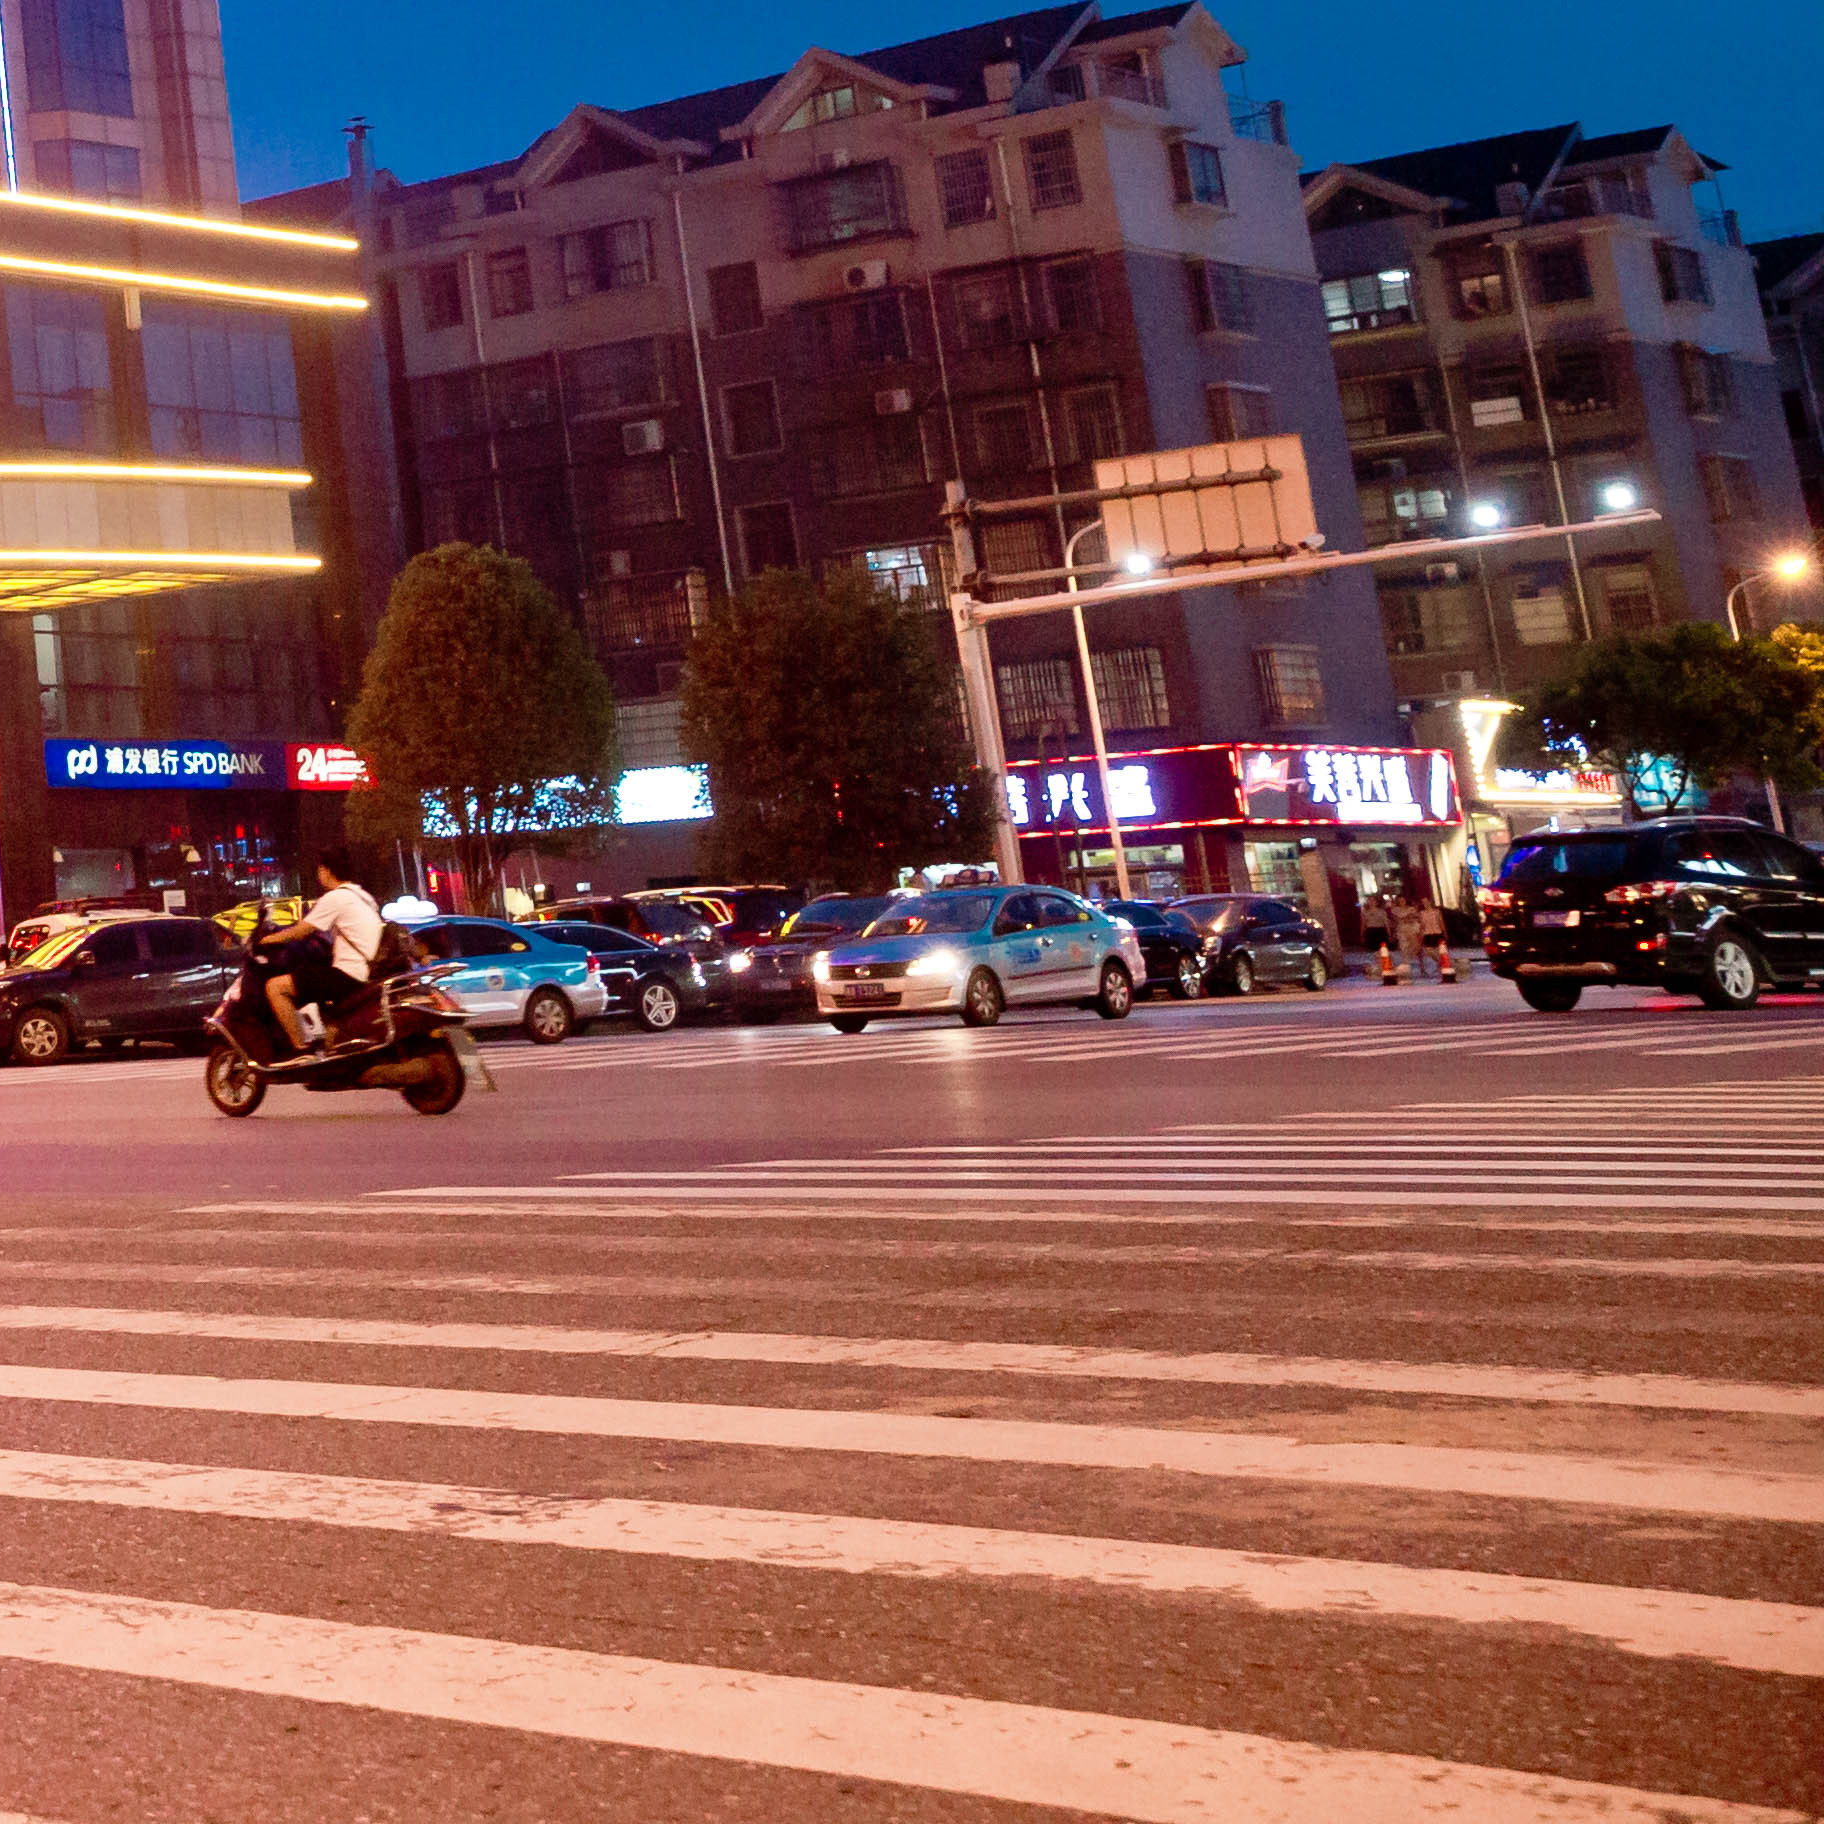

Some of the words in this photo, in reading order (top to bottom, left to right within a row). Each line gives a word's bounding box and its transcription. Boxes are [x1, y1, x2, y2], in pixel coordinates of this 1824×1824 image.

[104, 747, 180, 775] 浦发银行
[183, 750, 217, 775] SPD
[218, 752, 266, 775] BANK
[296, 747, 328, 782] 24
